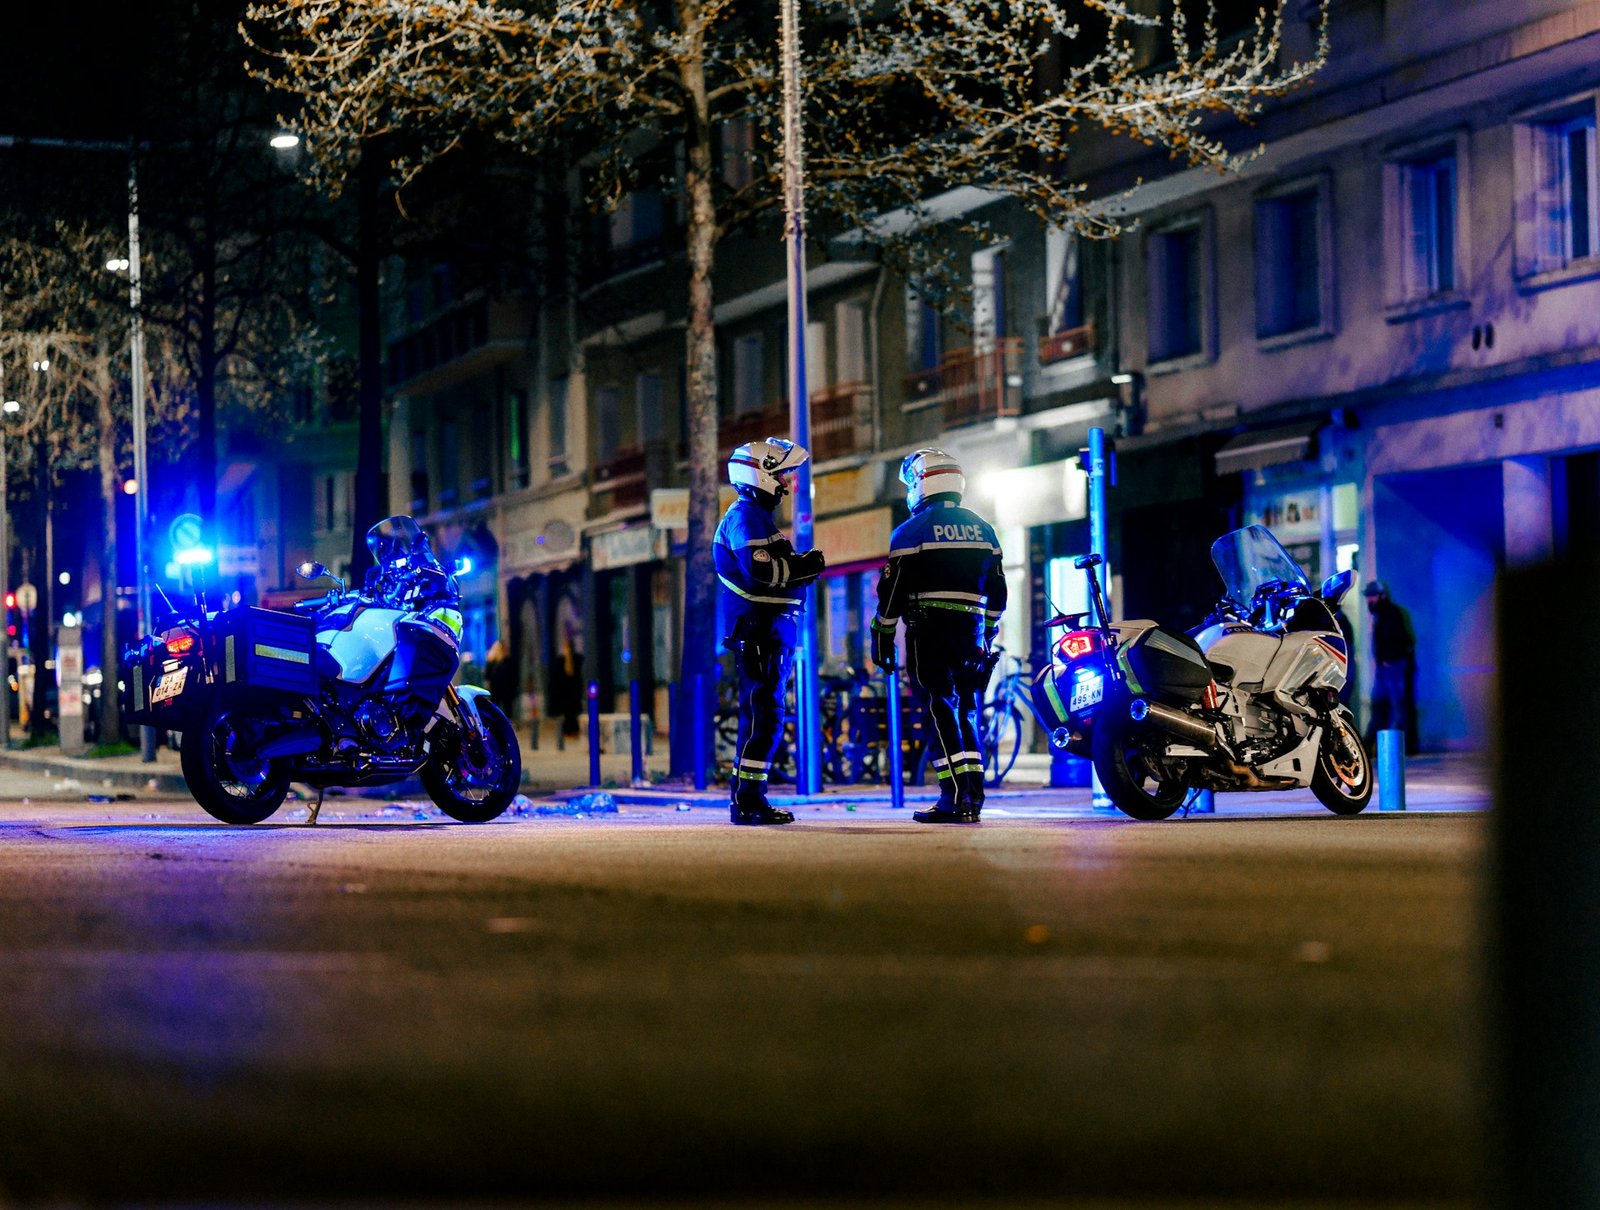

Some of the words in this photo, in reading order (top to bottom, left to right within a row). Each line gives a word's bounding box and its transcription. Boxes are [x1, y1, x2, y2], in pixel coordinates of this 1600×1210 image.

[933, 524, 984, 541] POLICE
[1072, 688, 1102, 706] 495-KN
[1080, 684, 1090, 694] FA
